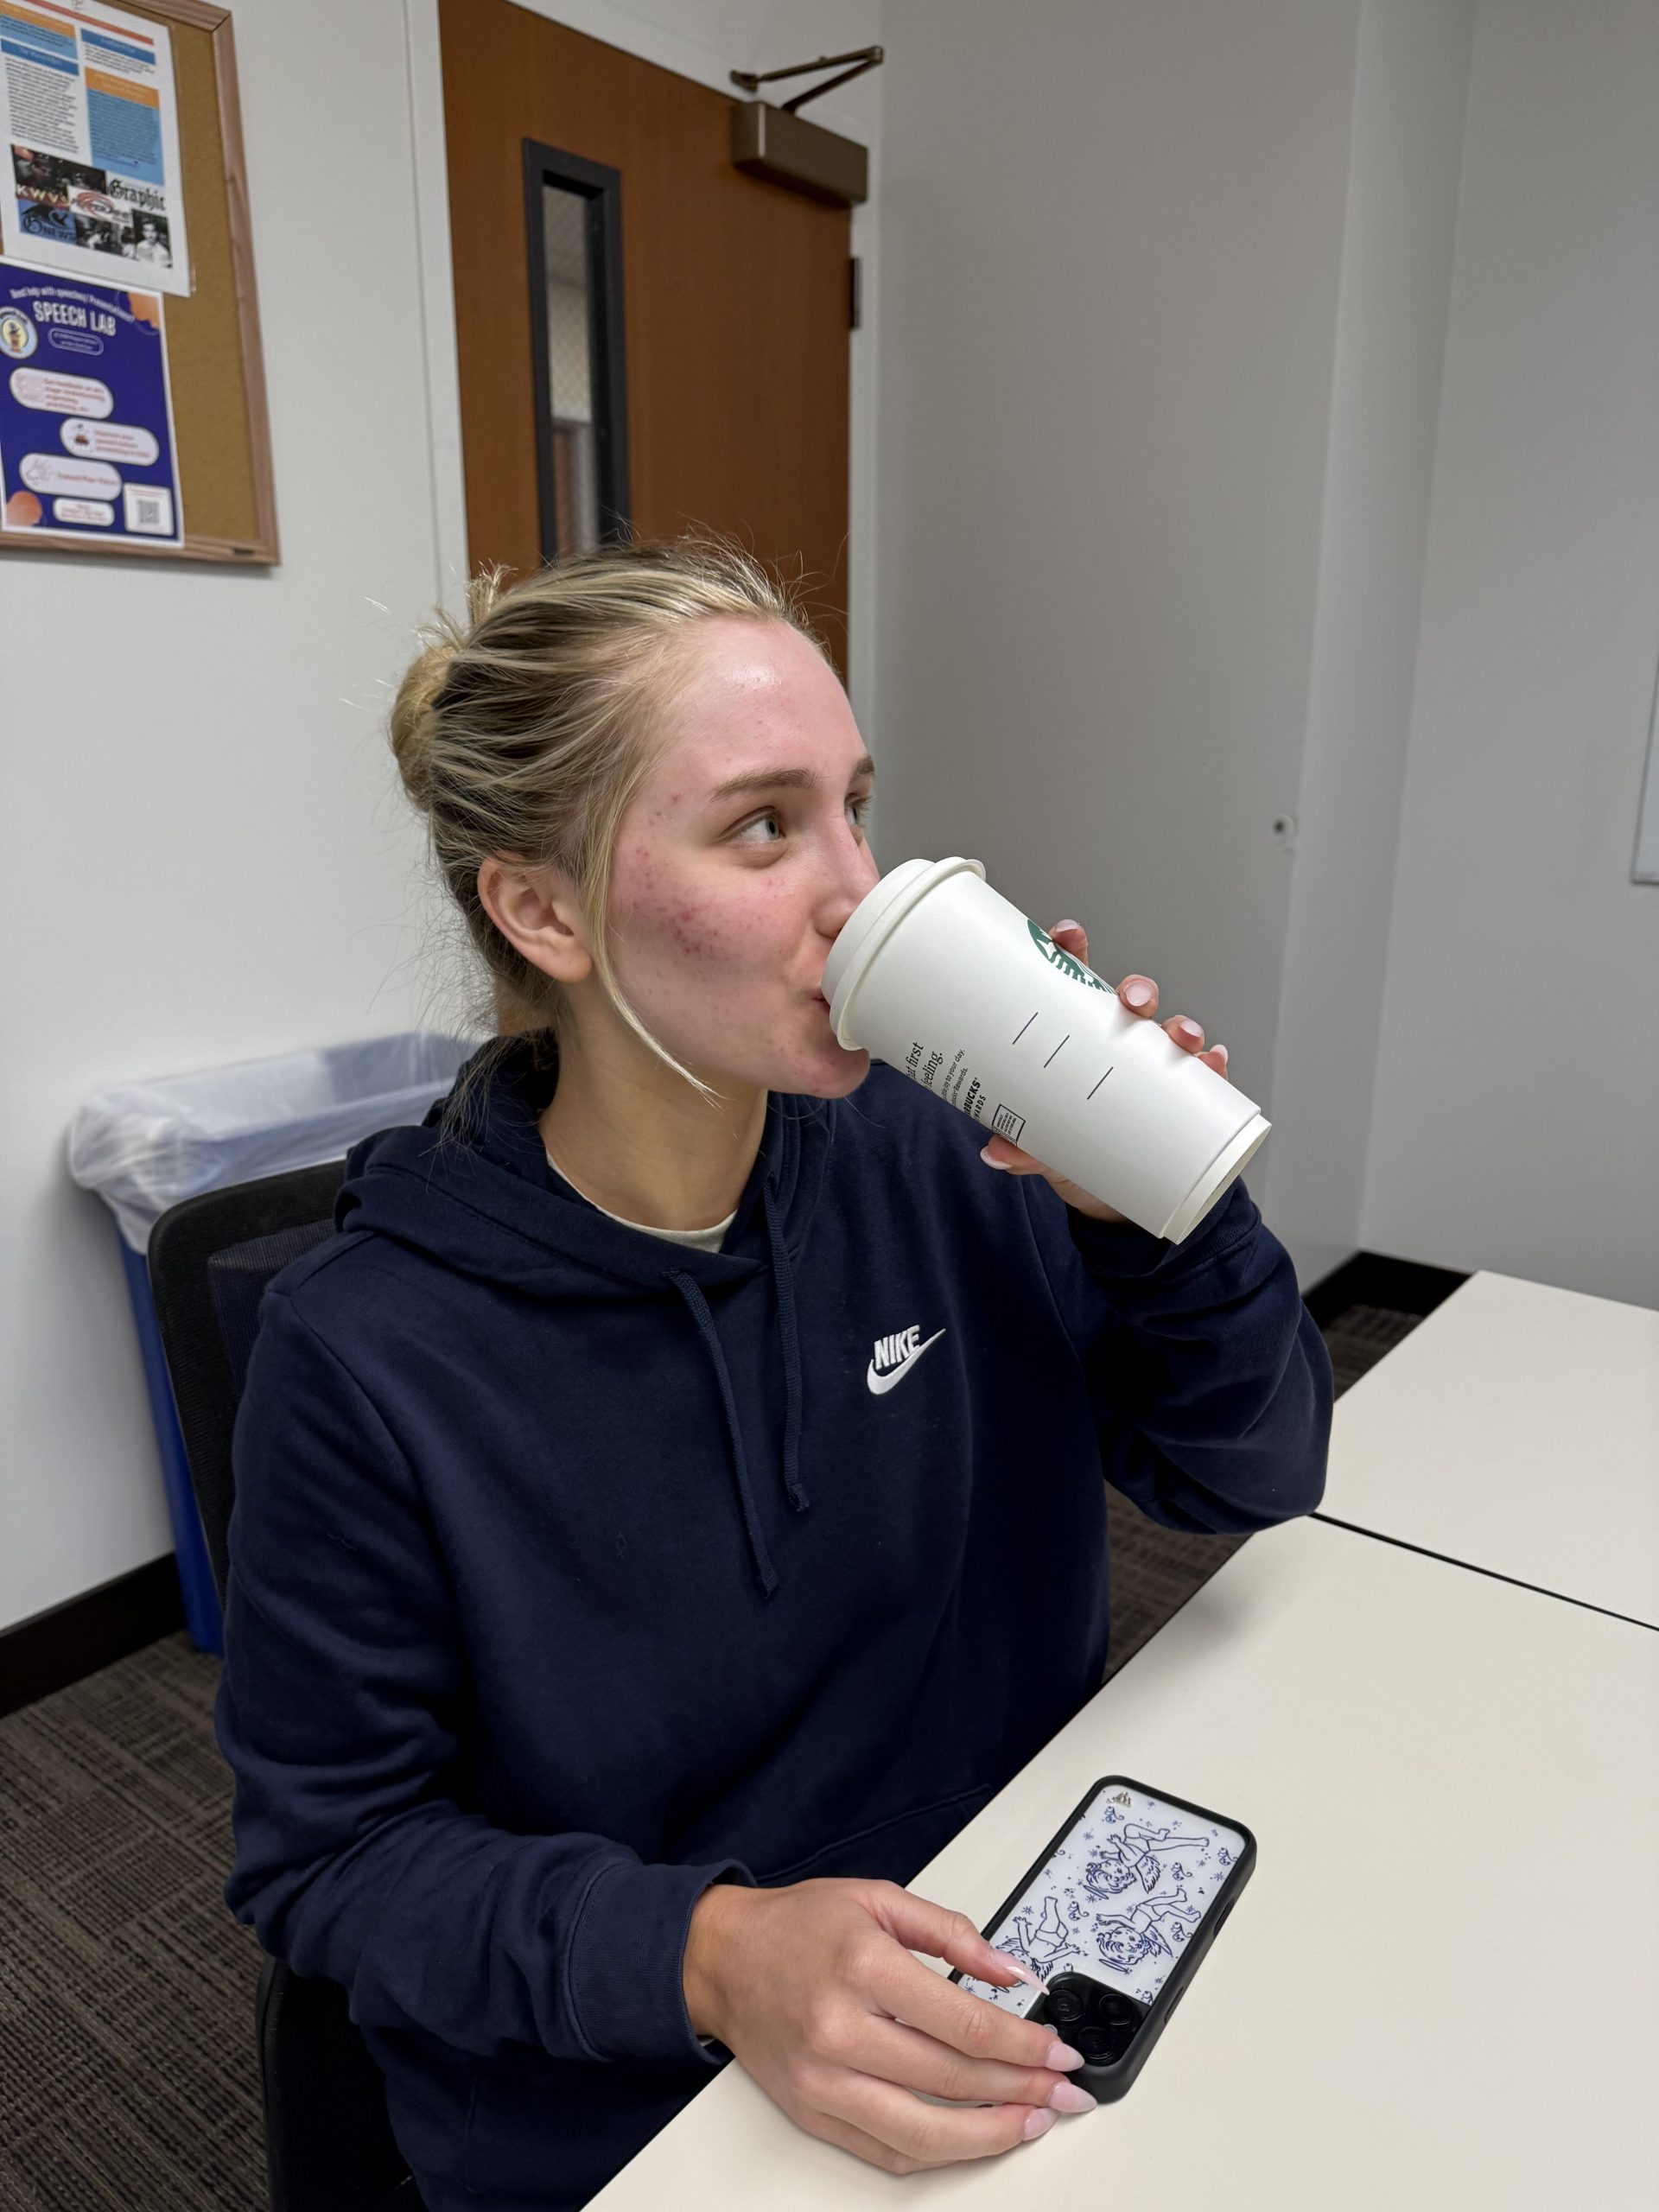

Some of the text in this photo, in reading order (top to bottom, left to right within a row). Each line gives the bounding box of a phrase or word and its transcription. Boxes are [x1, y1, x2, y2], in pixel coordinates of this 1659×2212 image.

[32, 300, 87, 329] SPEECH
[90, 310, 117, 336] LAB
[906, 1042, 924, 1067] first
[948, 1061, 957, 1077] your
[955, 1048, 965, 1063] day.
[874, 1324, 920, 1370] NIKE
